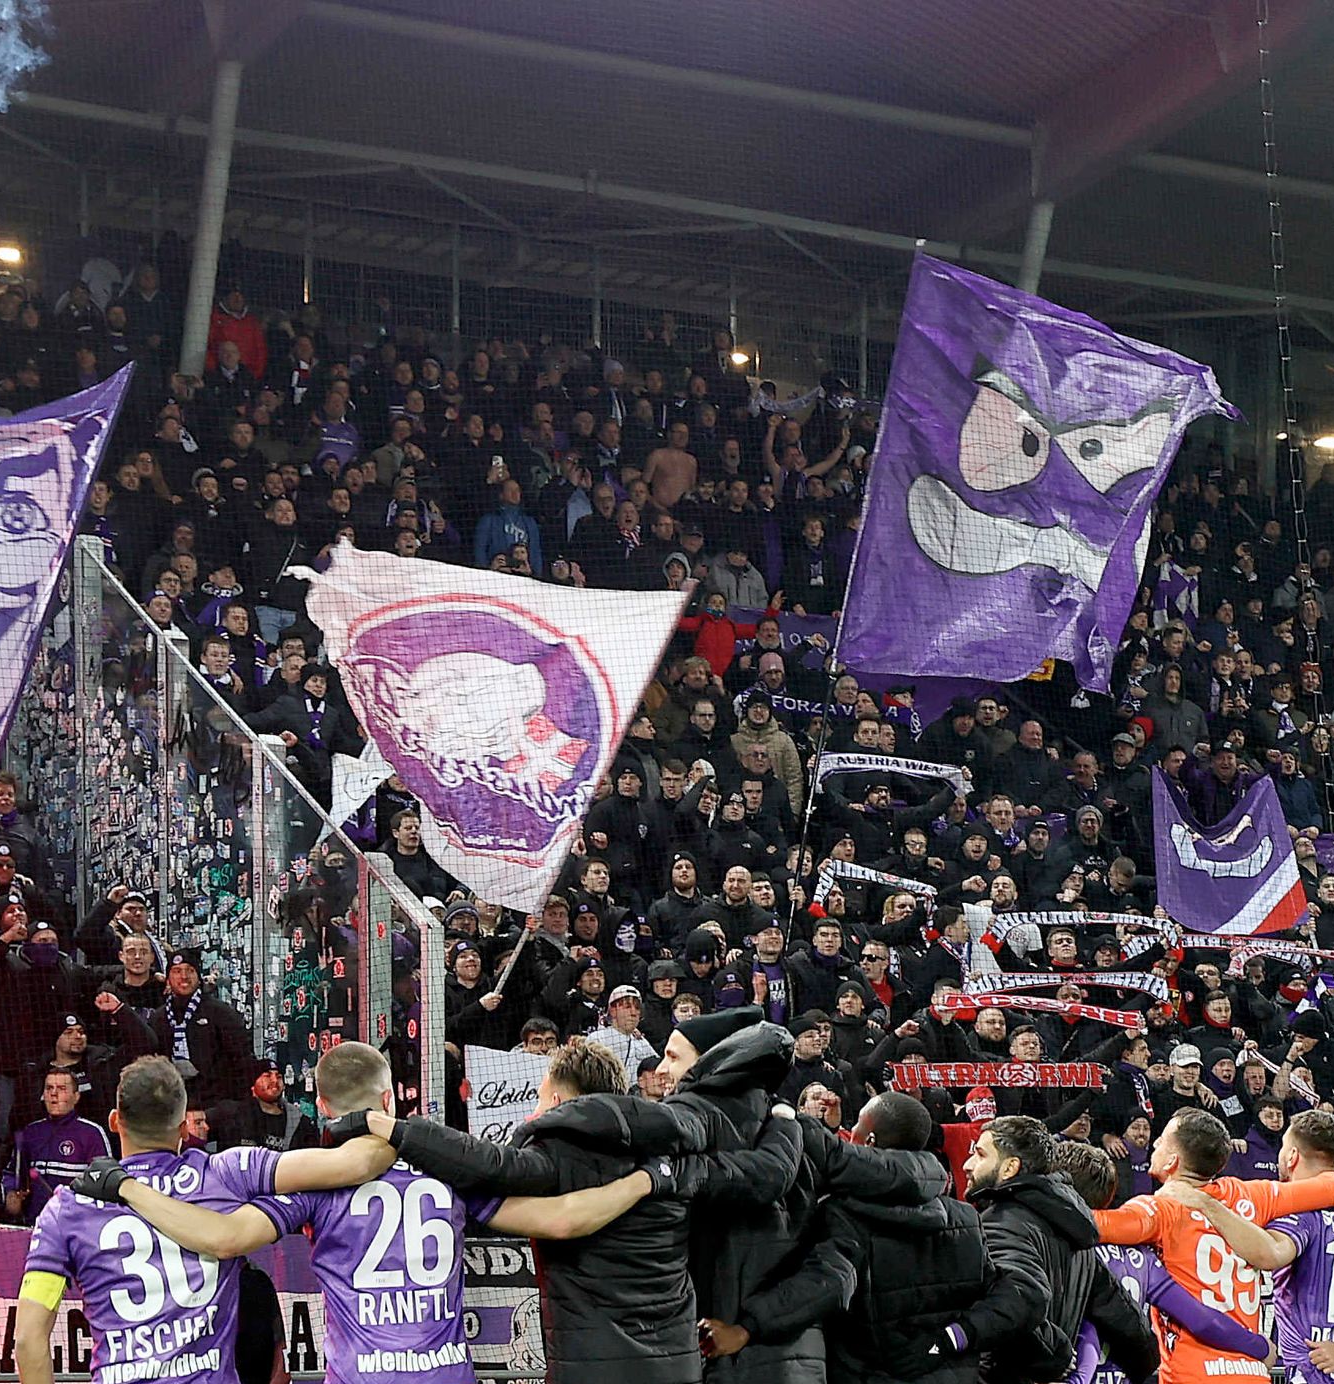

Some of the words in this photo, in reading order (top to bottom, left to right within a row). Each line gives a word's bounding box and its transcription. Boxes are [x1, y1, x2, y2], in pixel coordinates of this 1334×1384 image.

[836, 754, 900, 767] AUSTRIA
[99, 1214, 220, 1323] 30
[350, 1178, 455, 1289] 26
[1196, 1233, 1261, 1316] 99
[358, 1287, 456, 1326] RANFTL
